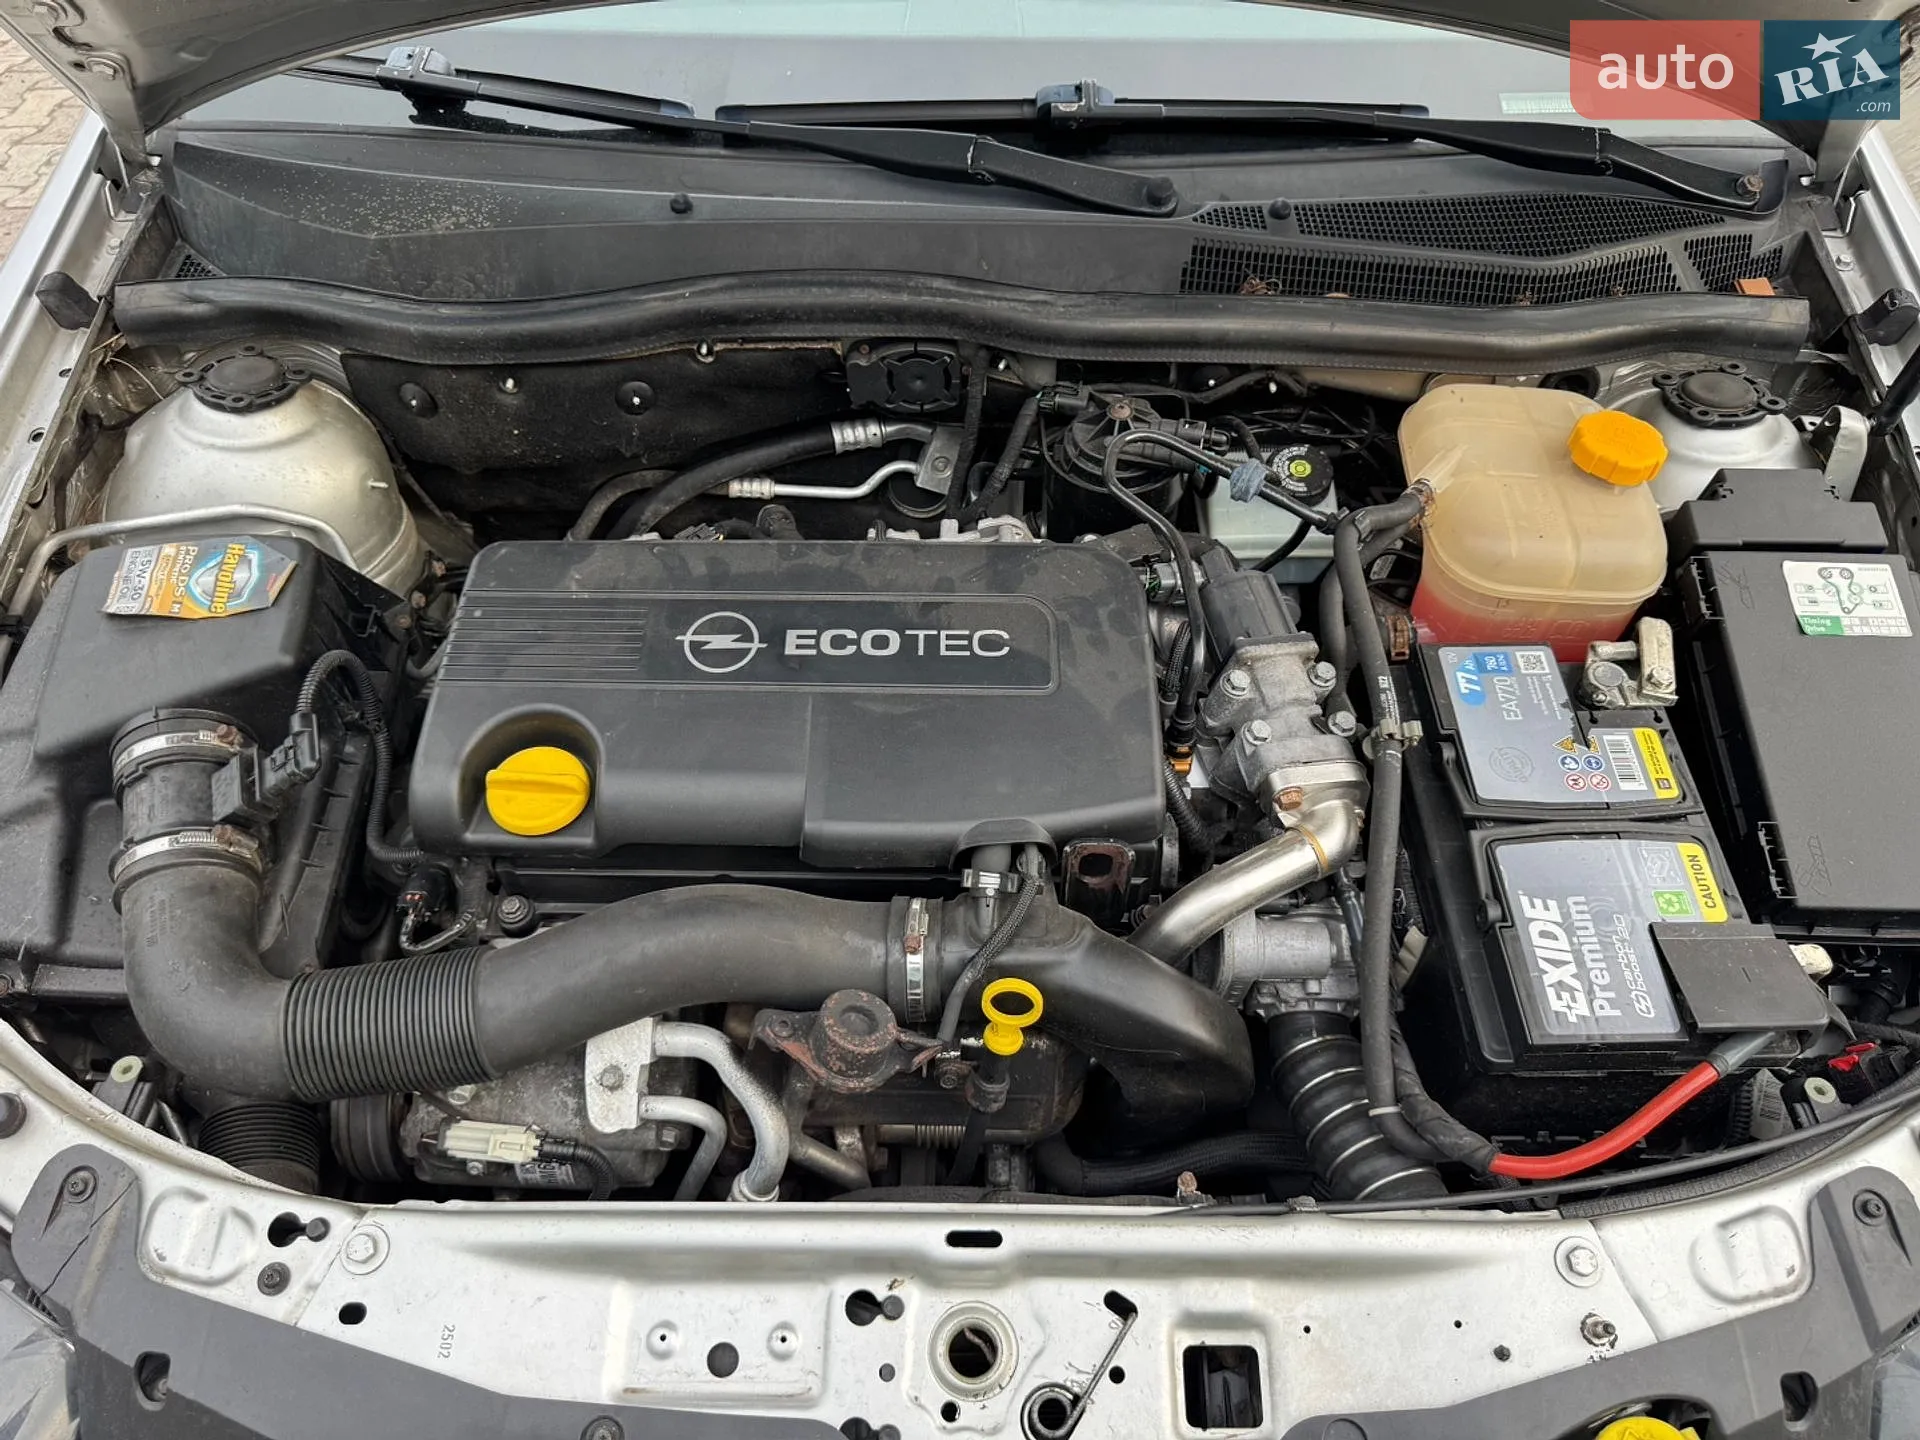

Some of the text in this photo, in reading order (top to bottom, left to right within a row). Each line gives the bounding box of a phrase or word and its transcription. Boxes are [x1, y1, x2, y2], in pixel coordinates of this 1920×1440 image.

[122, 550, 141, 584] ENGINE
[131, 559, 152, 601] 5W-30
[181, 546, 199, 574] PRO
[209, 543, 246, 614] Havoline
[174, 575, 189, 599] DS
[784, 629, 1011, 657] ECOTEC
[1456, 671, 1481, 694] 77
[1493, 676, 1523, 720] EA770
[1686, 854, 1717, 909] CAUTION
[1518, 894, 1591, 1024] EXIDE
[1566, 895, 1622, 1017] Premium
[1613, 935, 1636, 990] carbon
[1625, 942, 1647, 991] boost
[437, 1324, 456, 1359] 2502
